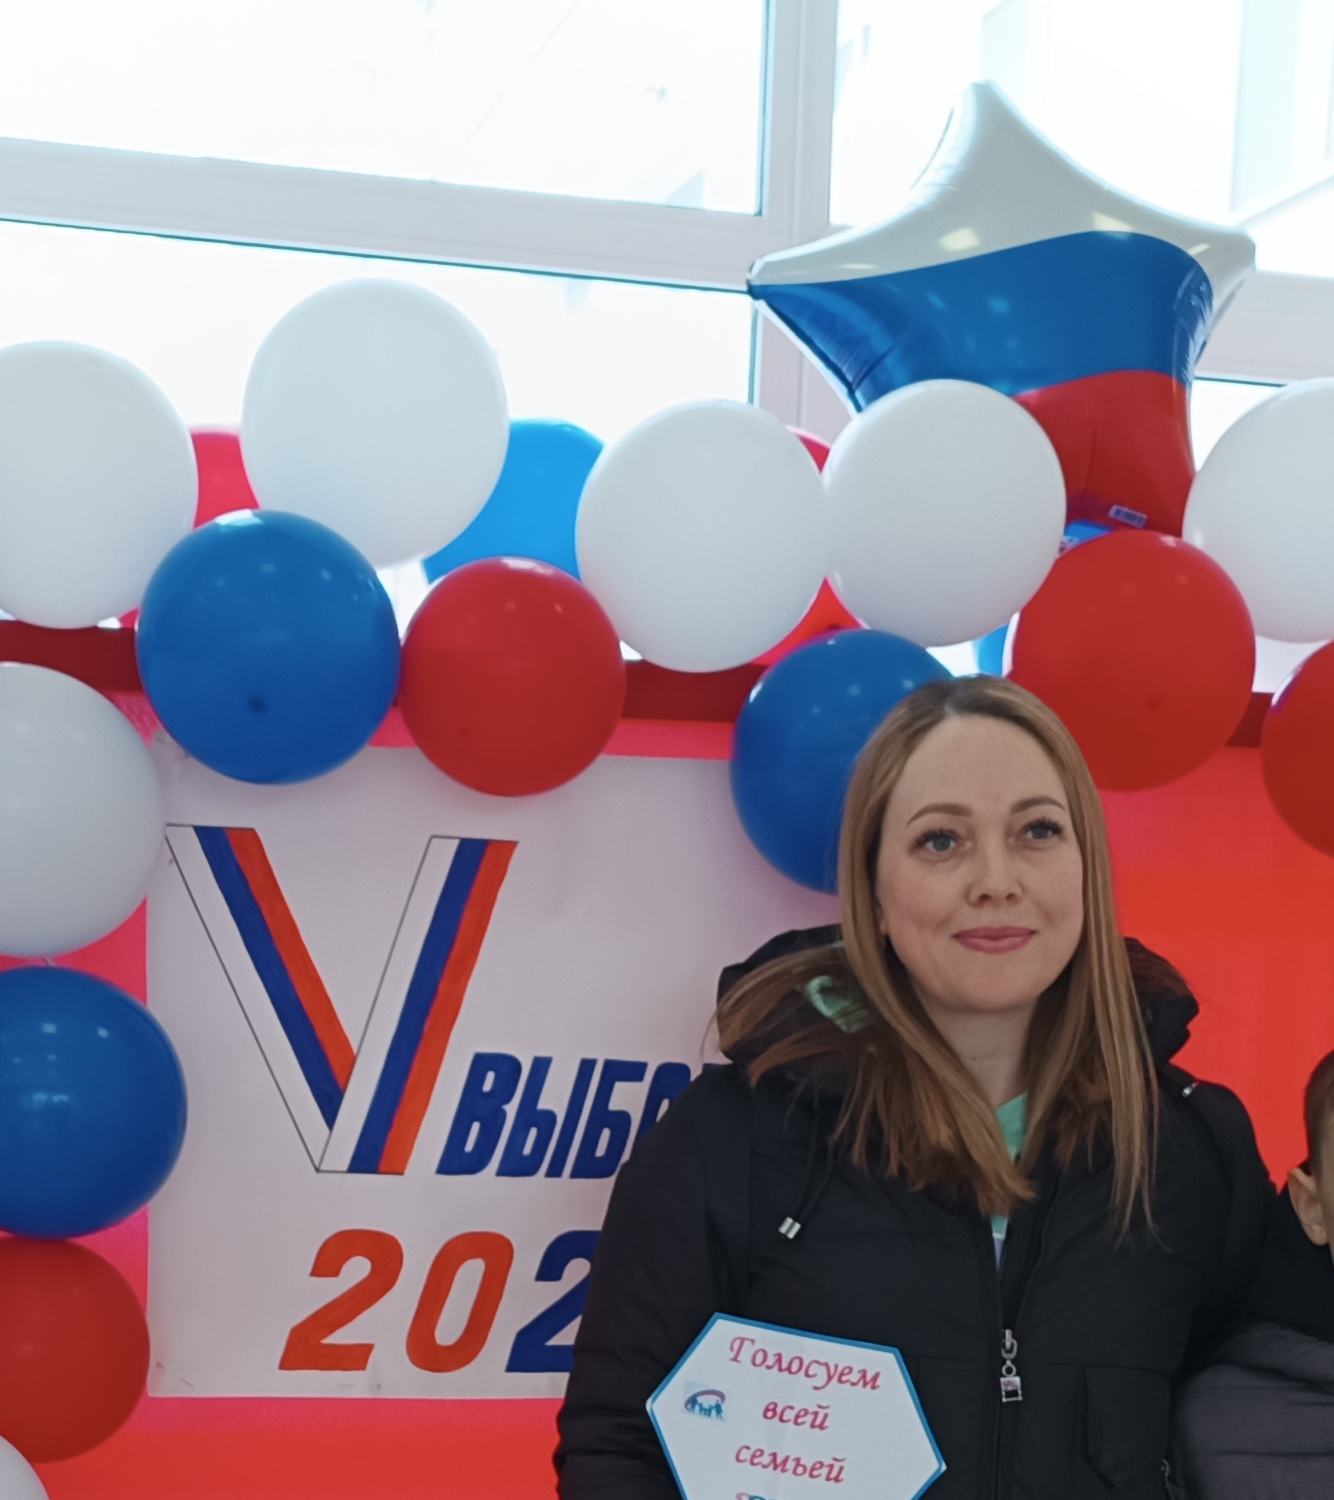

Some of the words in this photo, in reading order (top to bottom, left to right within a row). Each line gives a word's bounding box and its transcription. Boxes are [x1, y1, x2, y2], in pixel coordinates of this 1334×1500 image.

[729, 1337, 880, 1391] Голосуем
[762, 1401, 831, 1431] всей
[734, 1444, 845, 1483] семьей
